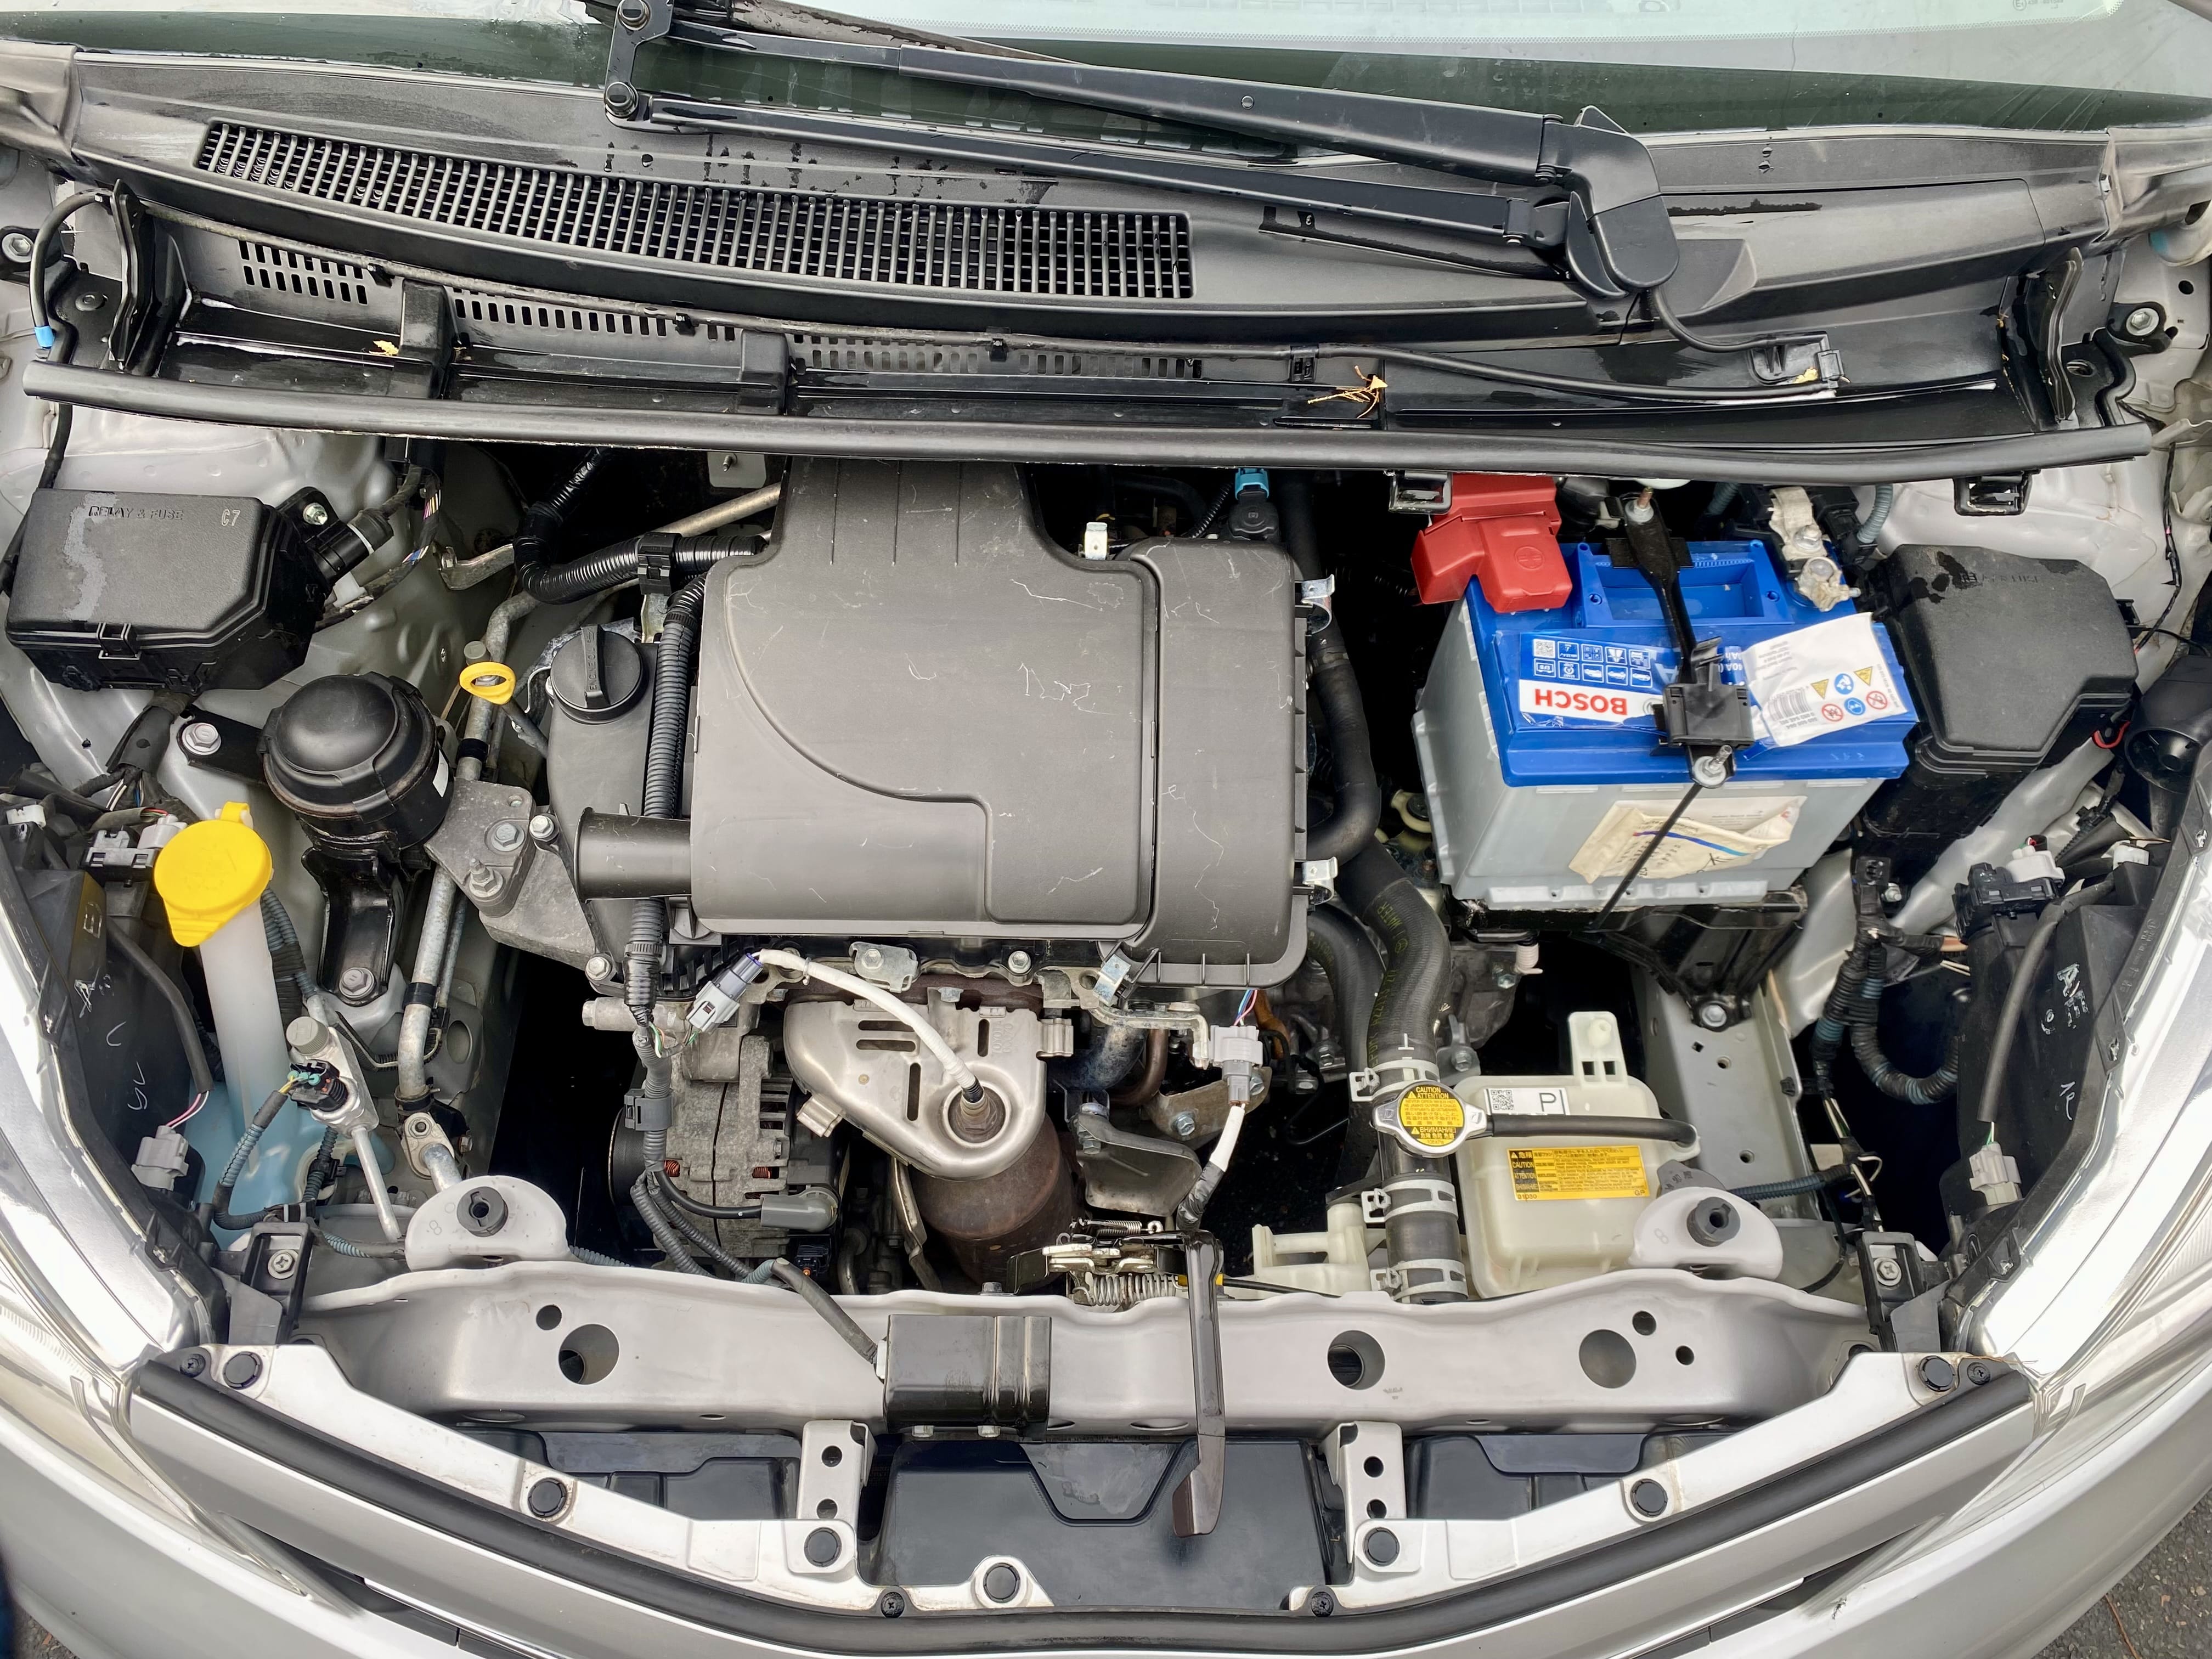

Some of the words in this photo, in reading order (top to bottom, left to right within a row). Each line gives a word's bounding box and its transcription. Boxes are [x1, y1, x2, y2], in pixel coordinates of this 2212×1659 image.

[88, 506, 134, 517] RELAY
[137, 509, 145, 518] &
[149, 509, 184, 521] FUSE
[1534, 689, 1628, 715] BOSCH
[1539, 1092, 1556, 1112] P
